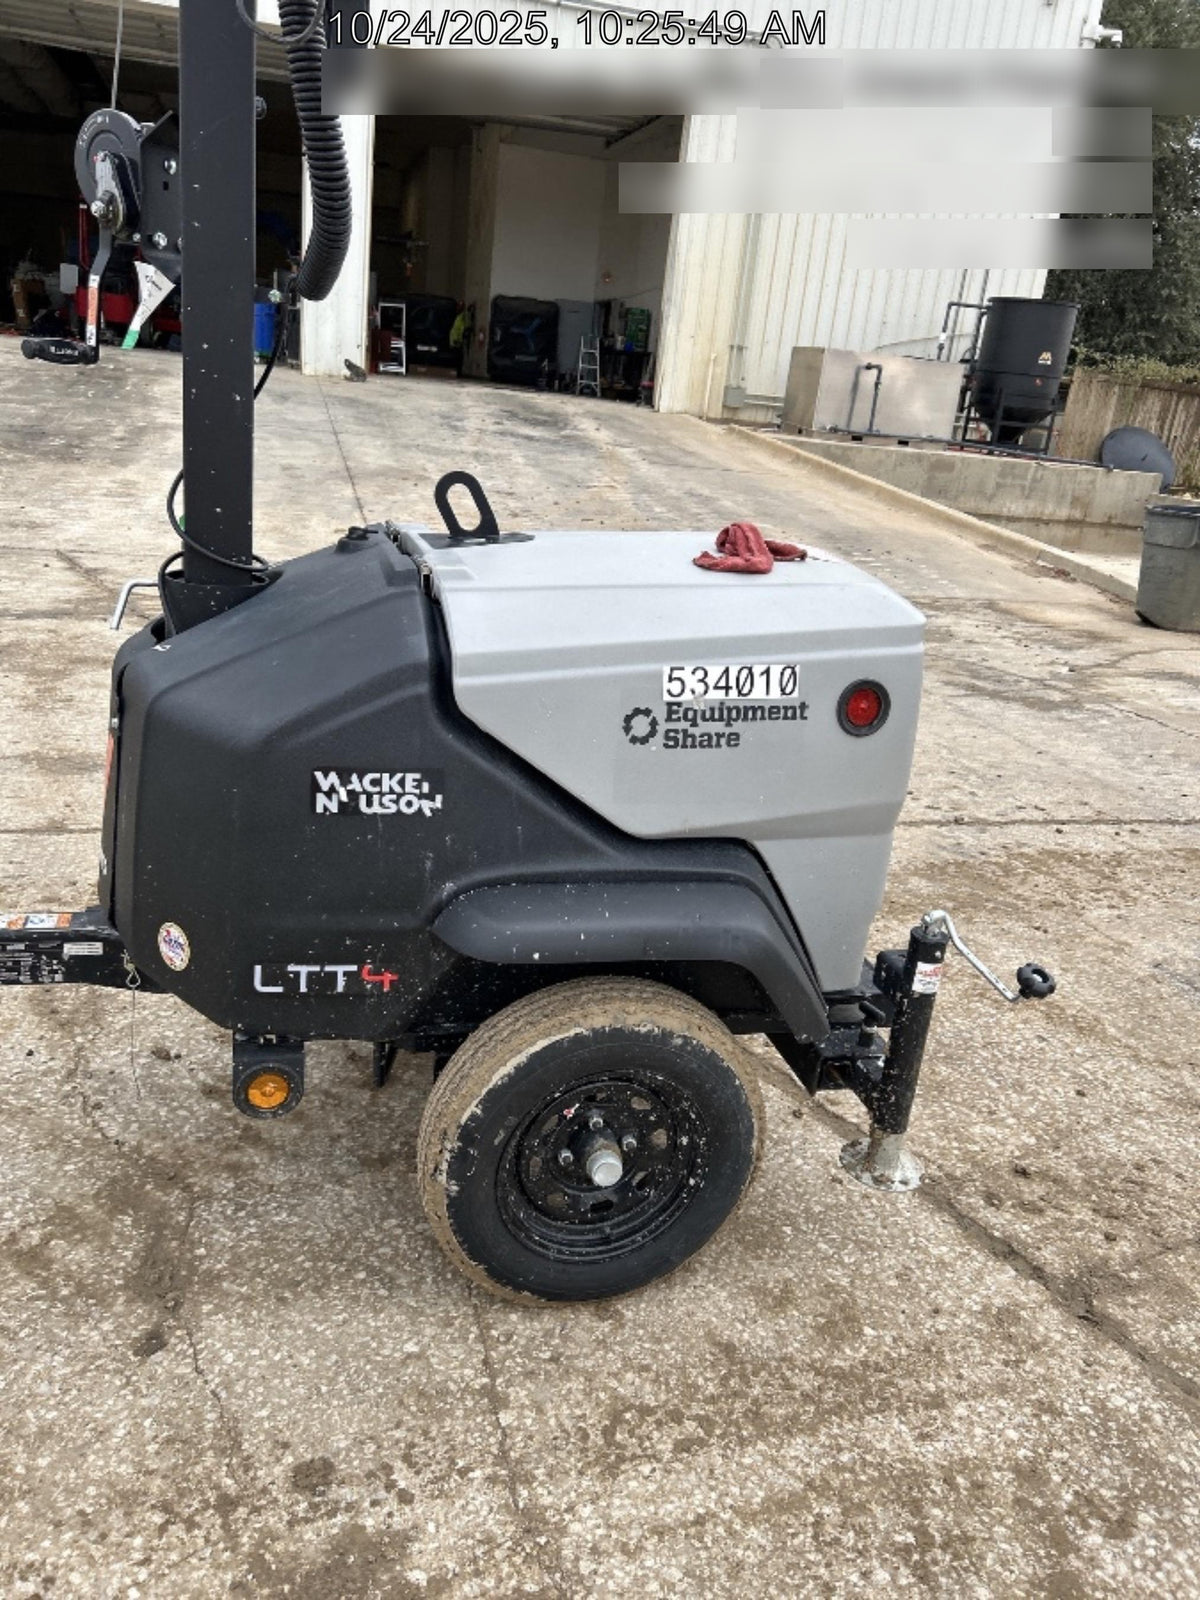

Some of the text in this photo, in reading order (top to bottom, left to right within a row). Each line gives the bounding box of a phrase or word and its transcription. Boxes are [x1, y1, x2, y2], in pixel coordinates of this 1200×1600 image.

[666, 665, 798, 698] 534010
[664, 701, 809, 727] Equipment
[662, 728, 741, 749] Share
[313, 771, 430, 795] WACKE
[253, 964, 399, 993] LTT4
